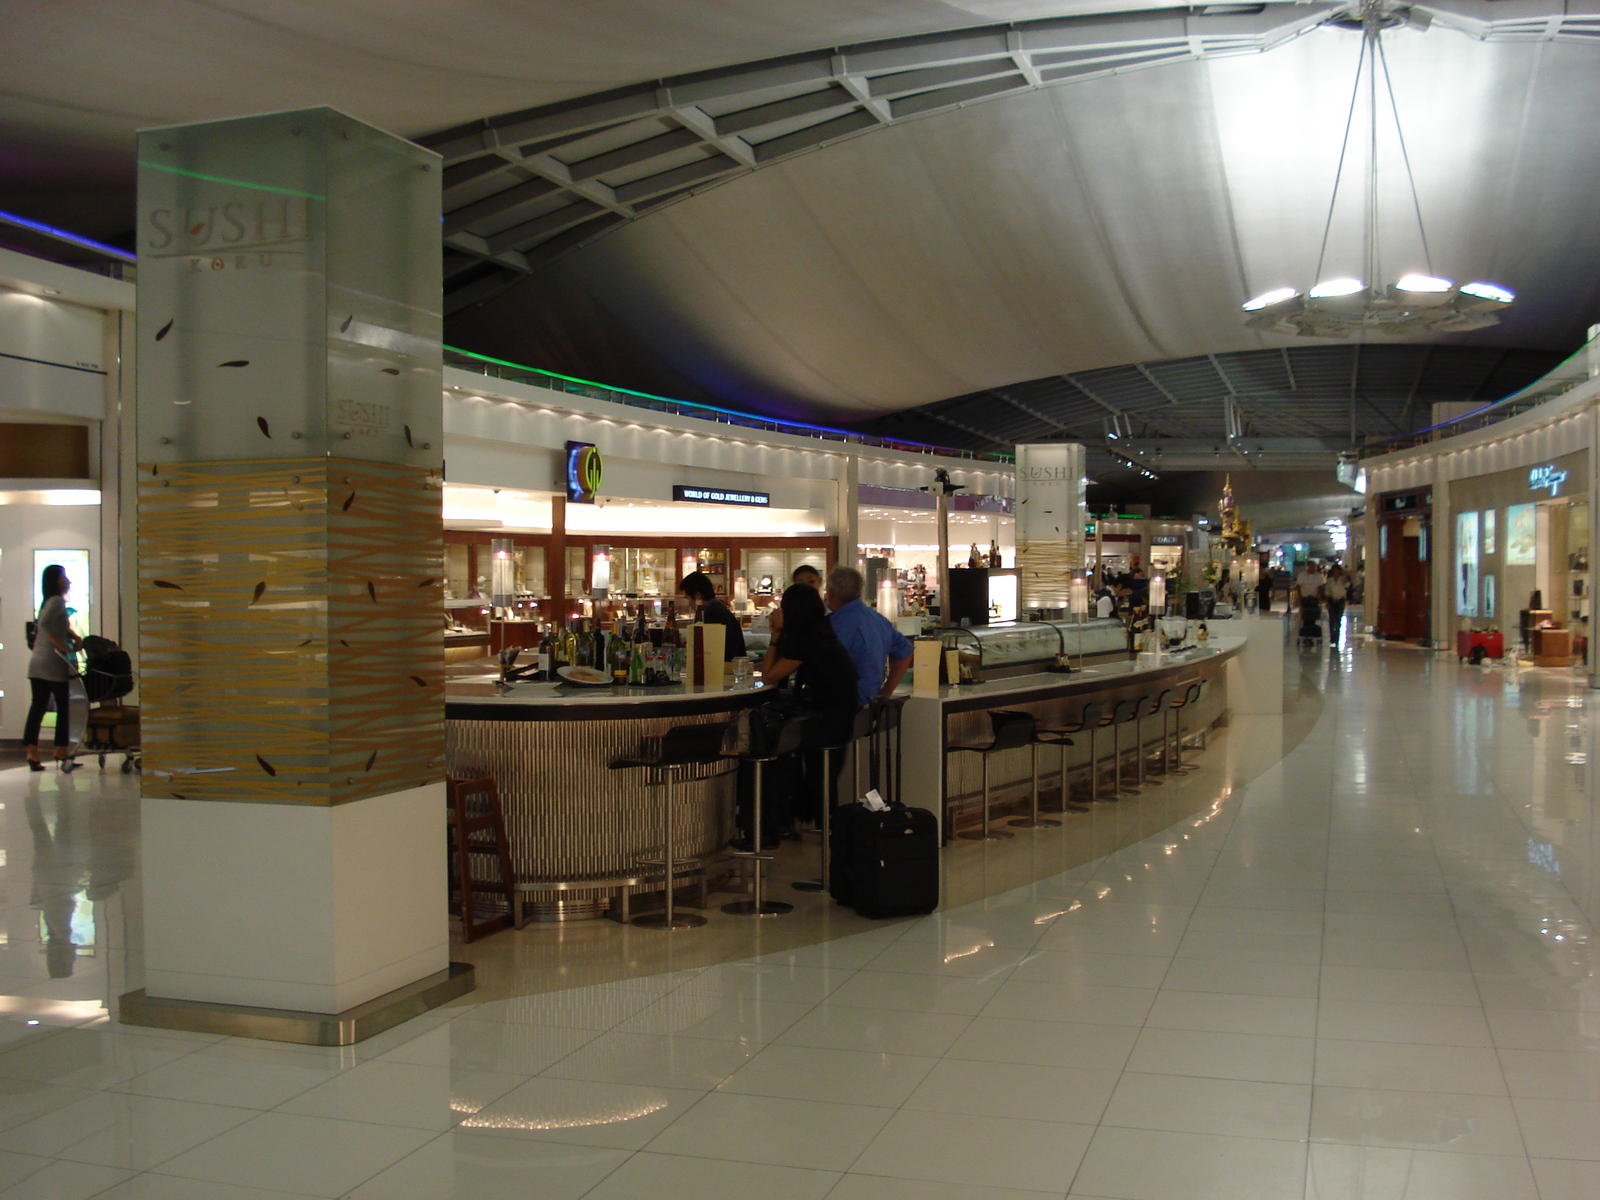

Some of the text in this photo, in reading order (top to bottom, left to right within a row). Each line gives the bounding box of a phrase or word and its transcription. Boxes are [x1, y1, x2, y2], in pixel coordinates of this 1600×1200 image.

[148, 198, 315, 249] SUSHI
[1020, 466, 1073, 479] SUSHI
[684, 489, 702, 499] WORLD
[703, 491, 710, 499] OF
[711, 492, 724, 501] GOLD
